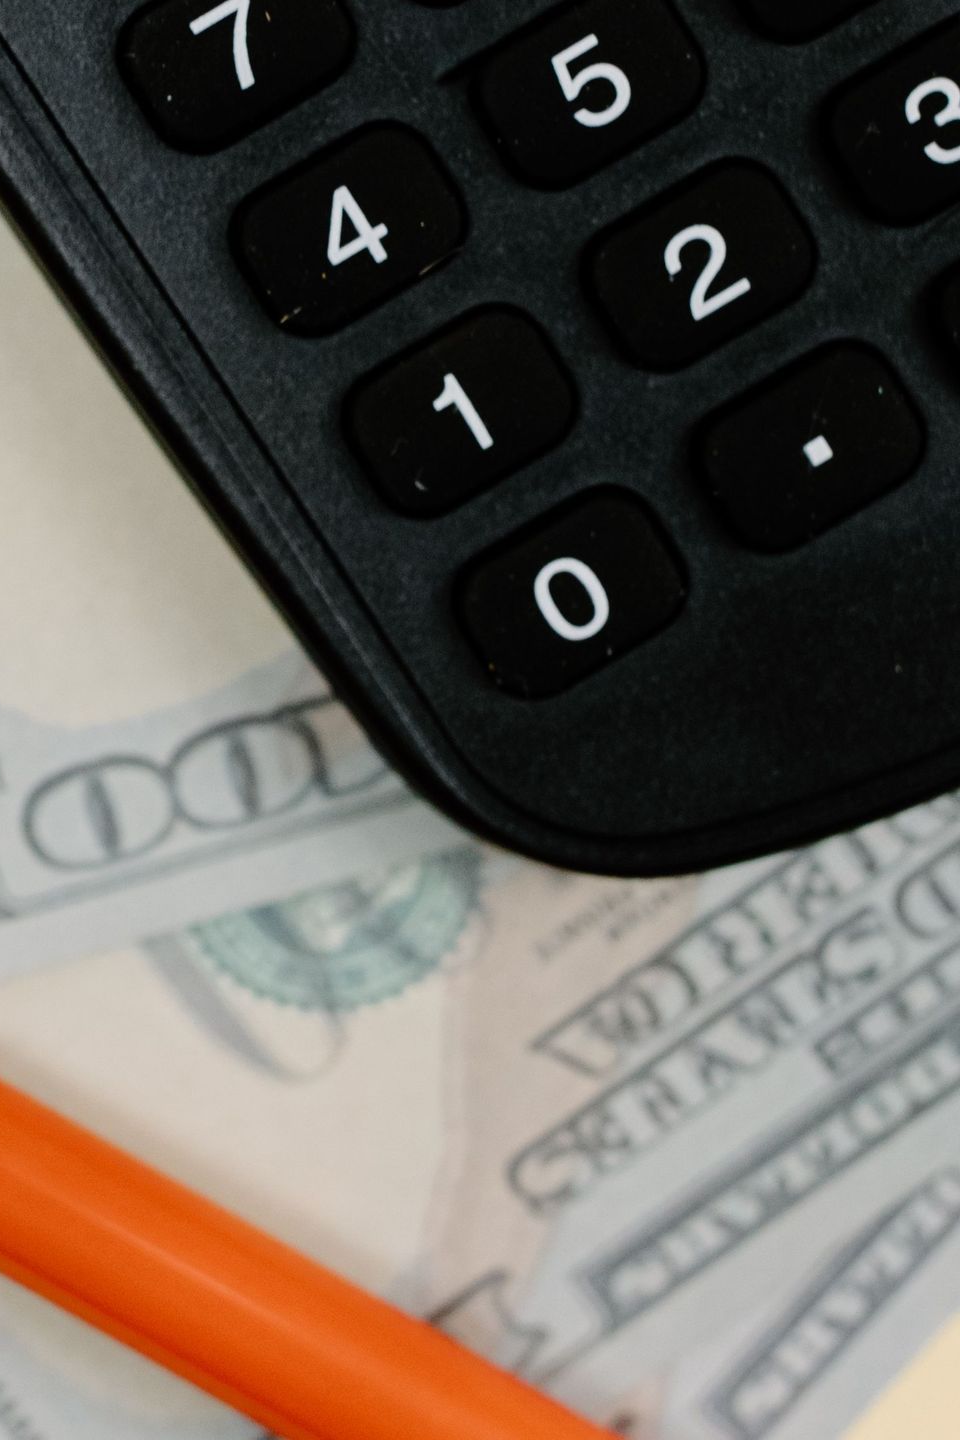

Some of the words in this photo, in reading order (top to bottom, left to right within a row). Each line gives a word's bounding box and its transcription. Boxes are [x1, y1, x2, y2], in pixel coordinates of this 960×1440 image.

[551, 33, 631, 127] 5
[905, 77, 960, 164] 3
[327, 185, 388, 266] 4
[664, 224, 751, 321] 2
[433, 373, 493, 450] 1
[534, 557, 609, 641] 0
